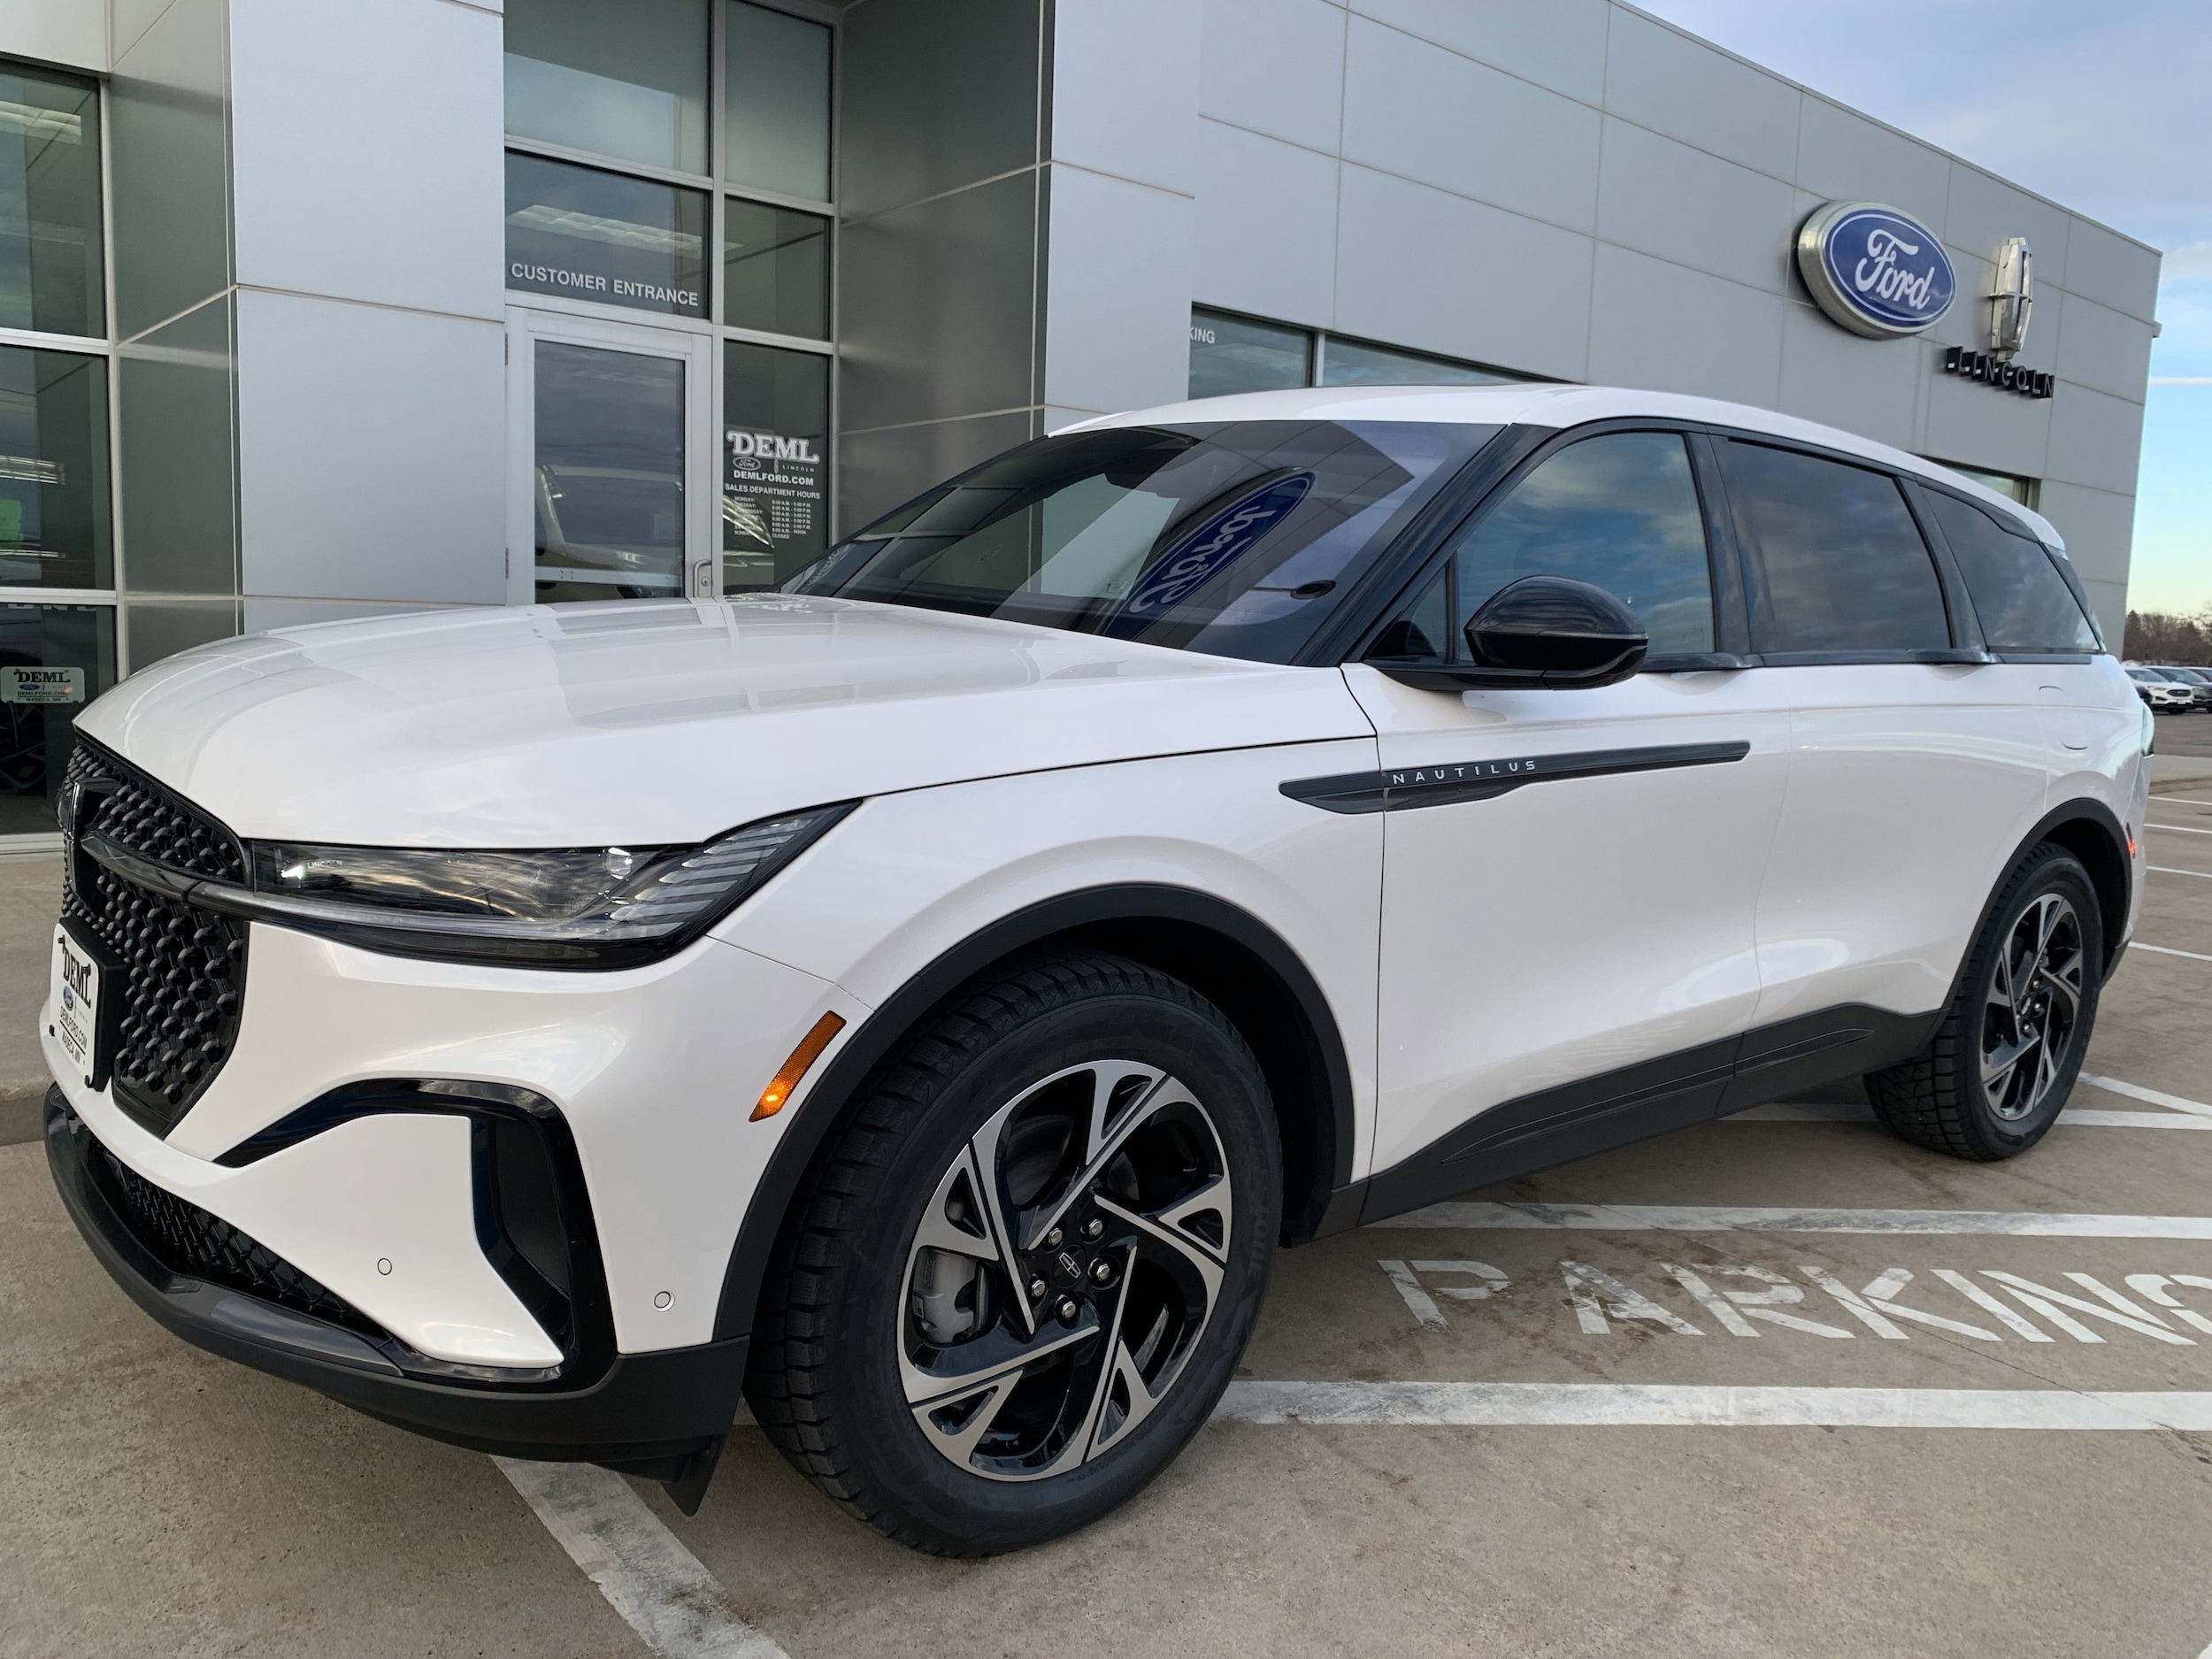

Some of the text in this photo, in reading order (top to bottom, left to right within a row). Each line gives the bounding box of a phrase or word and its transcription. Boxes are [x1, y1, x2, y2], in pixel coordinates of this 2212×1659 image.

[511, 263, 699, 306] CUSTOMER ENTRANCE
[1855, 229, 1935, 311] Ford
[1944, 346, 2055, 398] LINCOLN
[726, 431, 820, 465] DEML
[726, 483, 820, 500] SALES DEPARTMENT HOURS
[733, 470, 814, 486] DEMLFORD.COM
[13, 672, 71, 683] DEML
[1393, 760, 1535, 785] NAUTILUS
[307, 859, 342, 869] LINCON
[62, 944, 91, 1010] DEML
